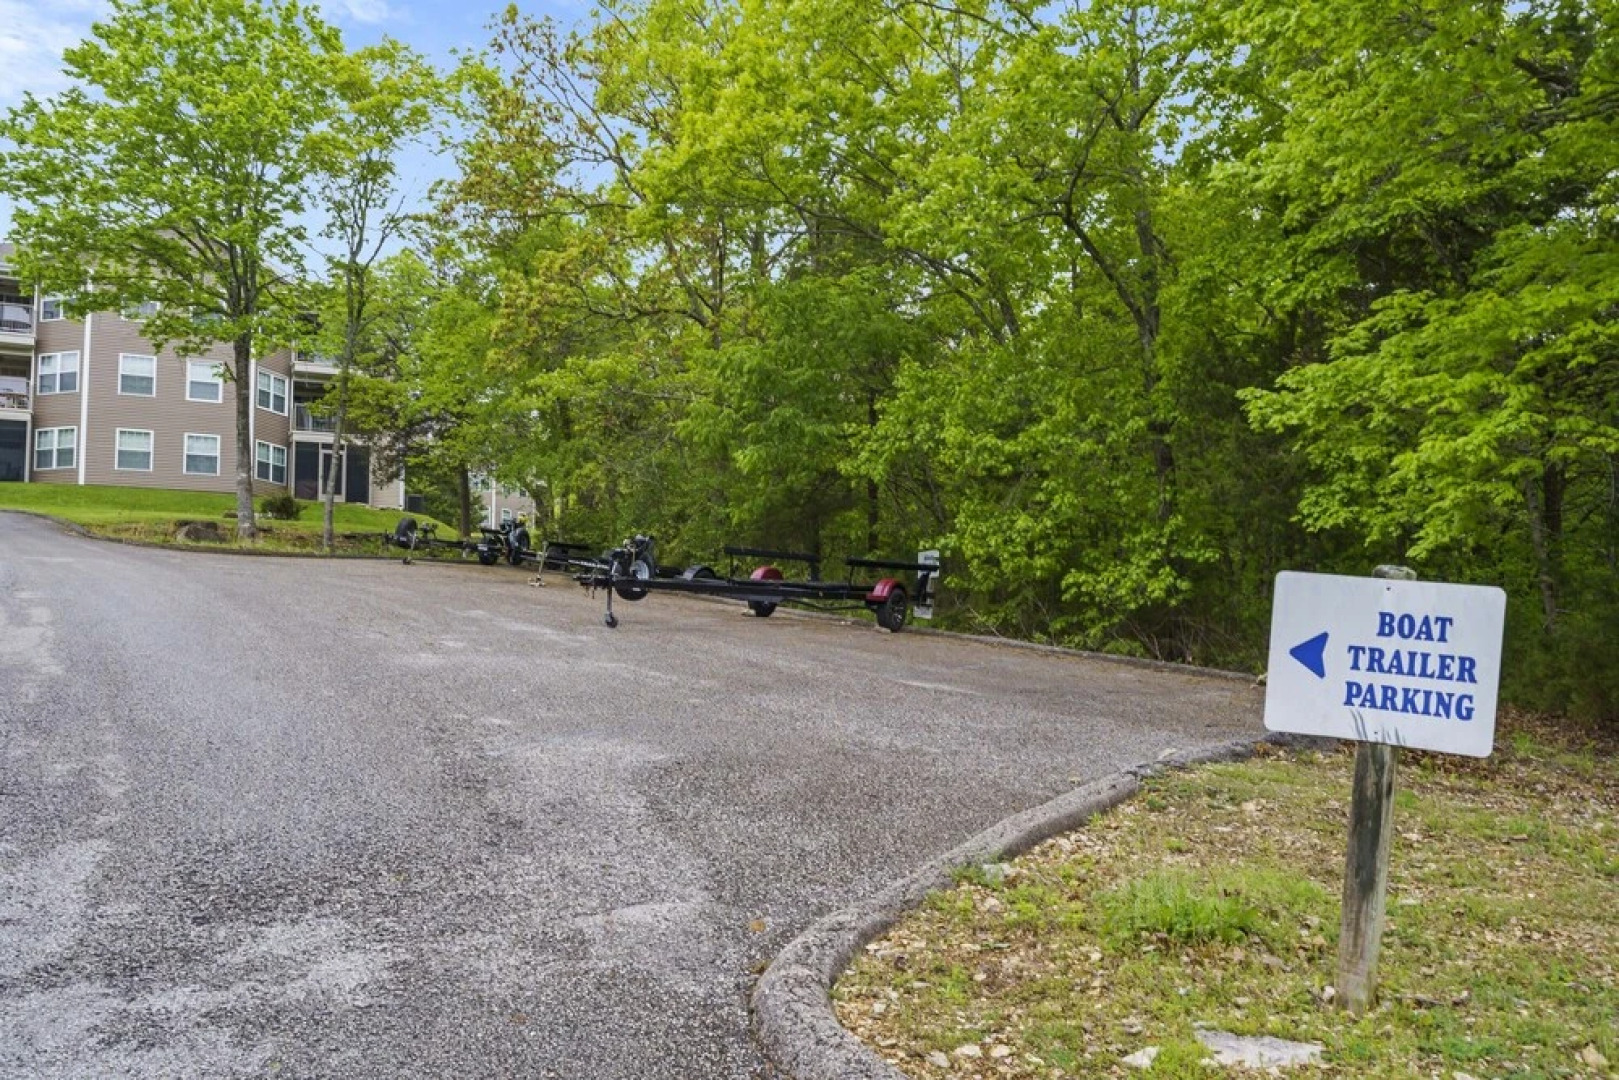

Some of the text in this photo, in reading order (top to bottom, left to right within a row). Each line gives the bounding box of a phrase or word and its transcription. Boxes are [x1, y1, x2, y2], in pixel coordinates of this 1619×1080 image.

[1377, 611, 1453, 643] BOAT
[1347, 645, 1477, 684] TRAILER
[1343, 681, 1475, 721] PARKING
